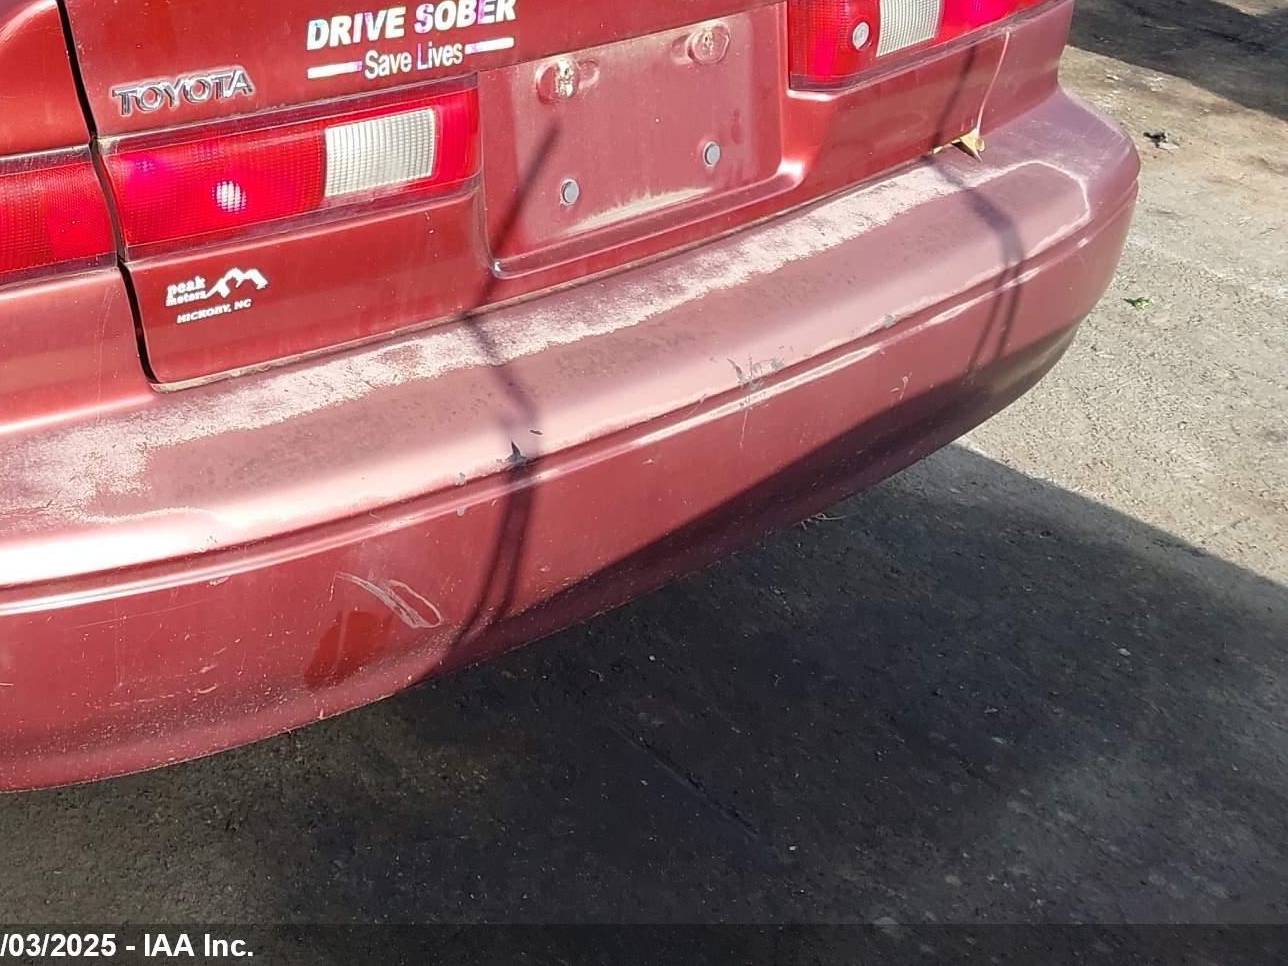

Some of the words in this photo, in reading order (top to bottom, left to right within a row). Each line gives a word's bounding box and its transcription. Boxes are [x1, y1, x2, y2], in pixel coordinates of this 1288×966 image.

[306, 6, 407, 50] DRIVE
[364, 49, 412, 79] Save
[417, 41, 463, 70] Lives
[111, 67, 254, 116] TOYOTA
[166, 275, 206, 298] peak
[233, 298, 252, 311] NC
